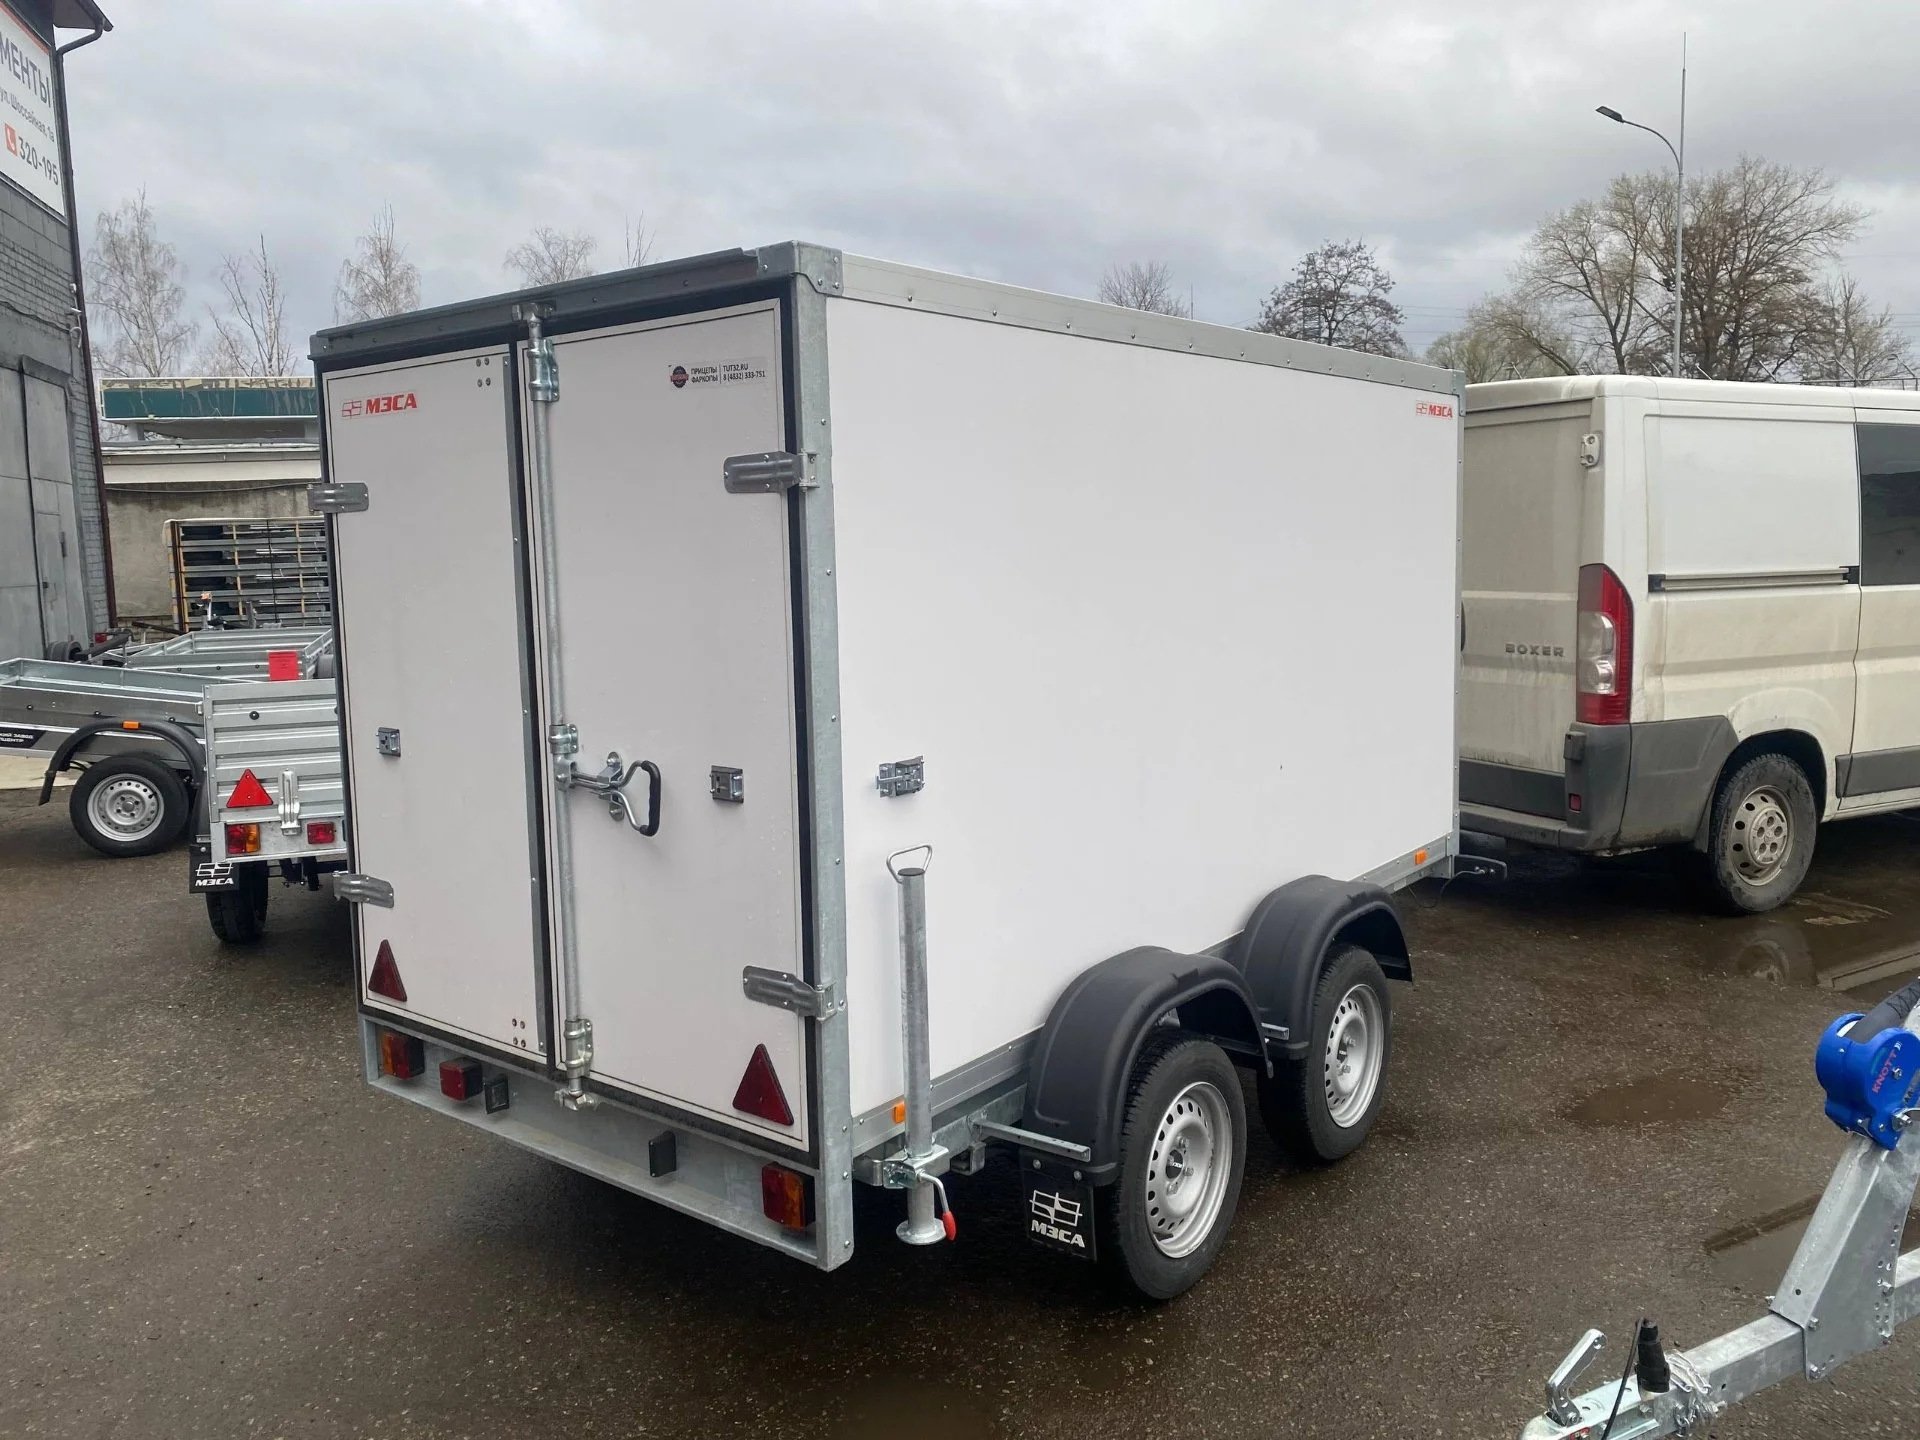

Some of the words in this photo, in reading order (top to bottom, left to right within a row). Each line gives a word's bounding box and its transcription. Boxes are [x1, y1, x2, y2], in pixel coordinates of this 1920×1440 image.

[18, 136, 59, 186] 320-195
[691, 366, 718, 375] ПРИЦЕПЫ
[691, 374, 718, 383] ФАРКОПЫ
[1505, 643, 1564, 657] BOXER
[1872, 1049, 1898, 1094] KNOTT
